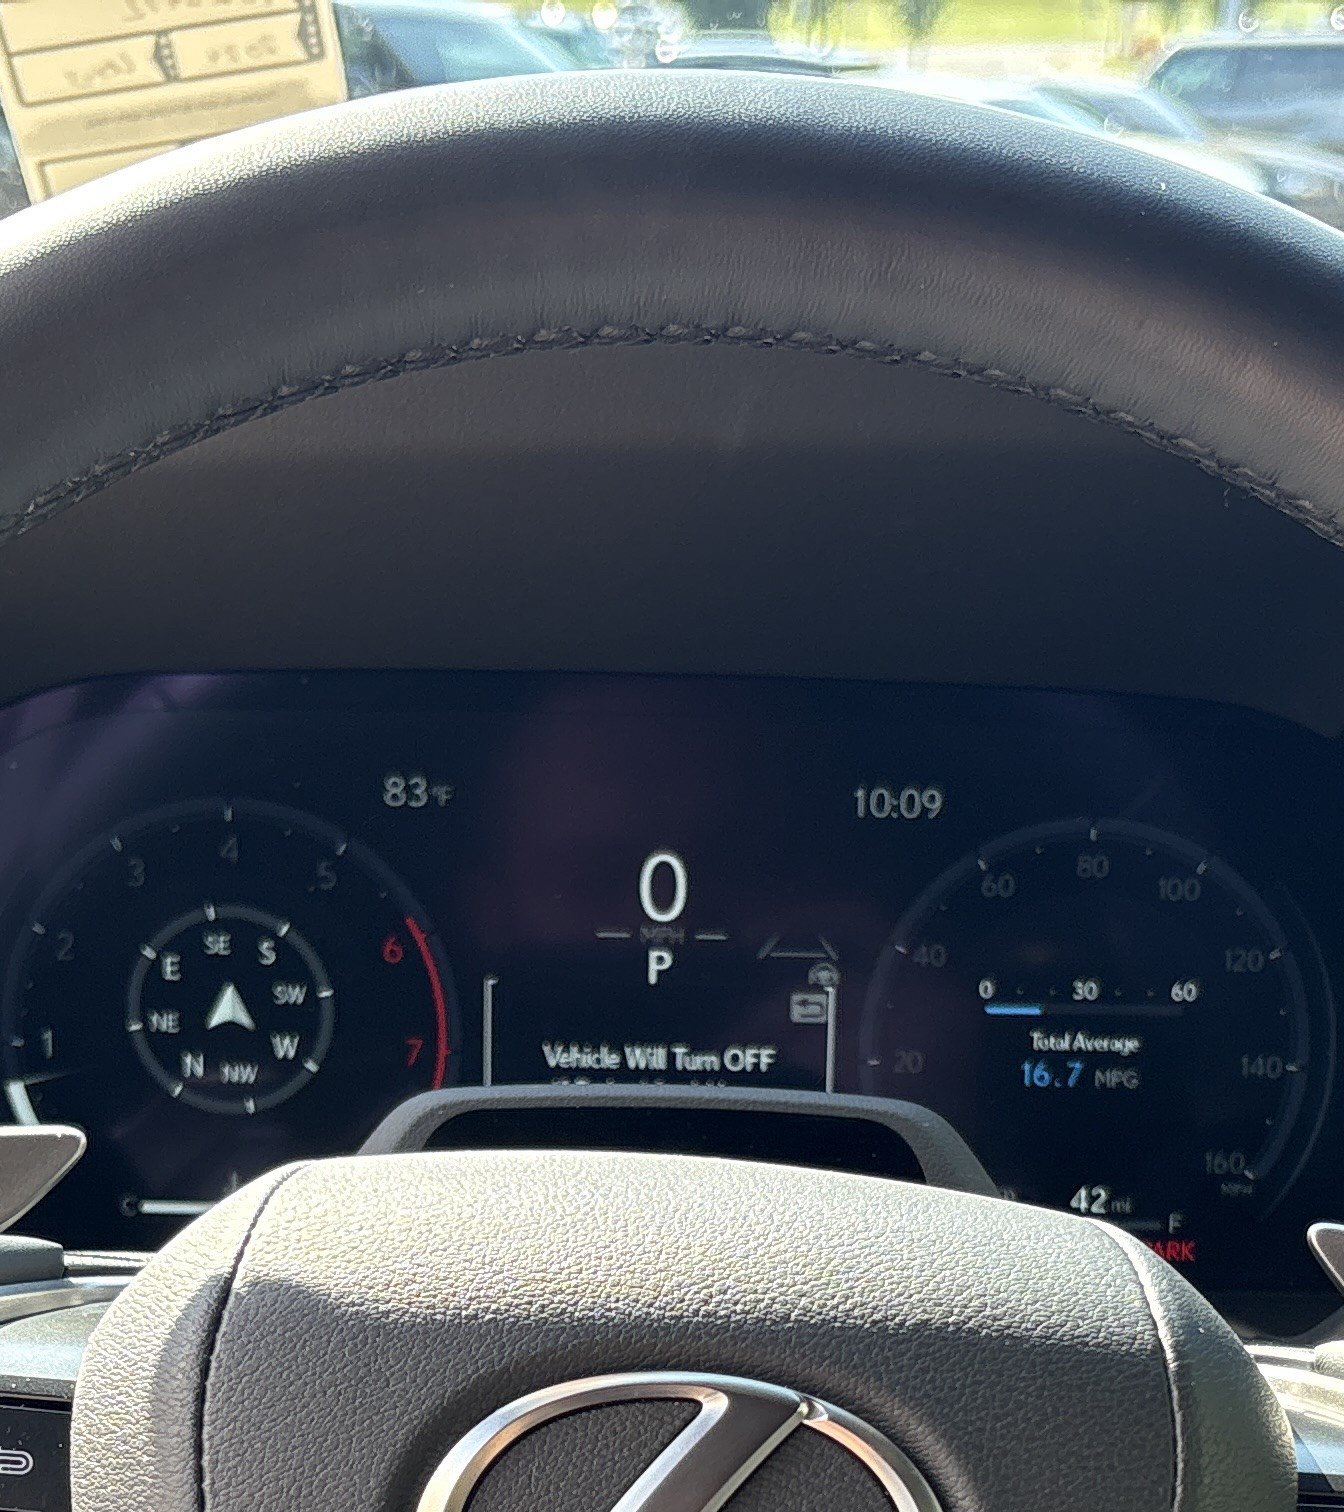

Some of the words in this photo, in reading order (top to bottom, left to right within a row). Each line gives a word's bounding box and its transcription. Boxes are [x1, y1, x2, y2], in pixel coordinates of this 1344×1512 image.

[853, 784, 944, 819] 10:09
[220, 837, 241, 864] 4
[127, 858, 147, 888] 3
[316, 861, 338, 891] 5
[1076, 854, 1111, 881] 80
[638, 851, 690, 924] 0
[980, 872, 1016, 899] 60
[1158, 876, 1202, 902] 100
[57, 931, 75, 962] 2
[203, 932, 232, 957] SE
[256, 939, 277, 967] S
[382, 936, 403, 965] 6
[913, 943, 947, 969] 40
[162, 953, 182, 982] E
[647, 948, 674, 986] P
[1224, 946, 1264, 973] 120
[271, 982, 308, 1007] SW
[978, 979, 996, 1000] 0
[1071, 980, 1100, 1002] 30
[1170, 980, 1200, 1003] 60
[149, 1011, 181, 1035] NE
[41, 1029, 54, 1059] 1
[269, 1033, 301, 1061] W
[404, 1038, 424, 1067] 7
[541, 1039, 621, 1070] Vehicle
[623, 1041, 668, 1071] Will
[669, 1042, 722, 1072] Turn
[722, 1043, 777, 1073] OFF
[1029, 1029, 1070, 1052] Total
[1072, 1031, 1142, 1057] Average
[180, 1051, 205, 1078] N
[219, 1061, 260, 1085] NW
[893, 1048, 926, 1075] 20
[1020, 1059, 1085, 1088] 16.7
[1240, 1053, 1283, 1079] 140
[1204, 1147, 1247, 1175] 160
[1069, 1183, 1111, 1215] 42
[1167, 1210, 1185, 1235] F
[1145, 1237, 1199, 1264] ARK
